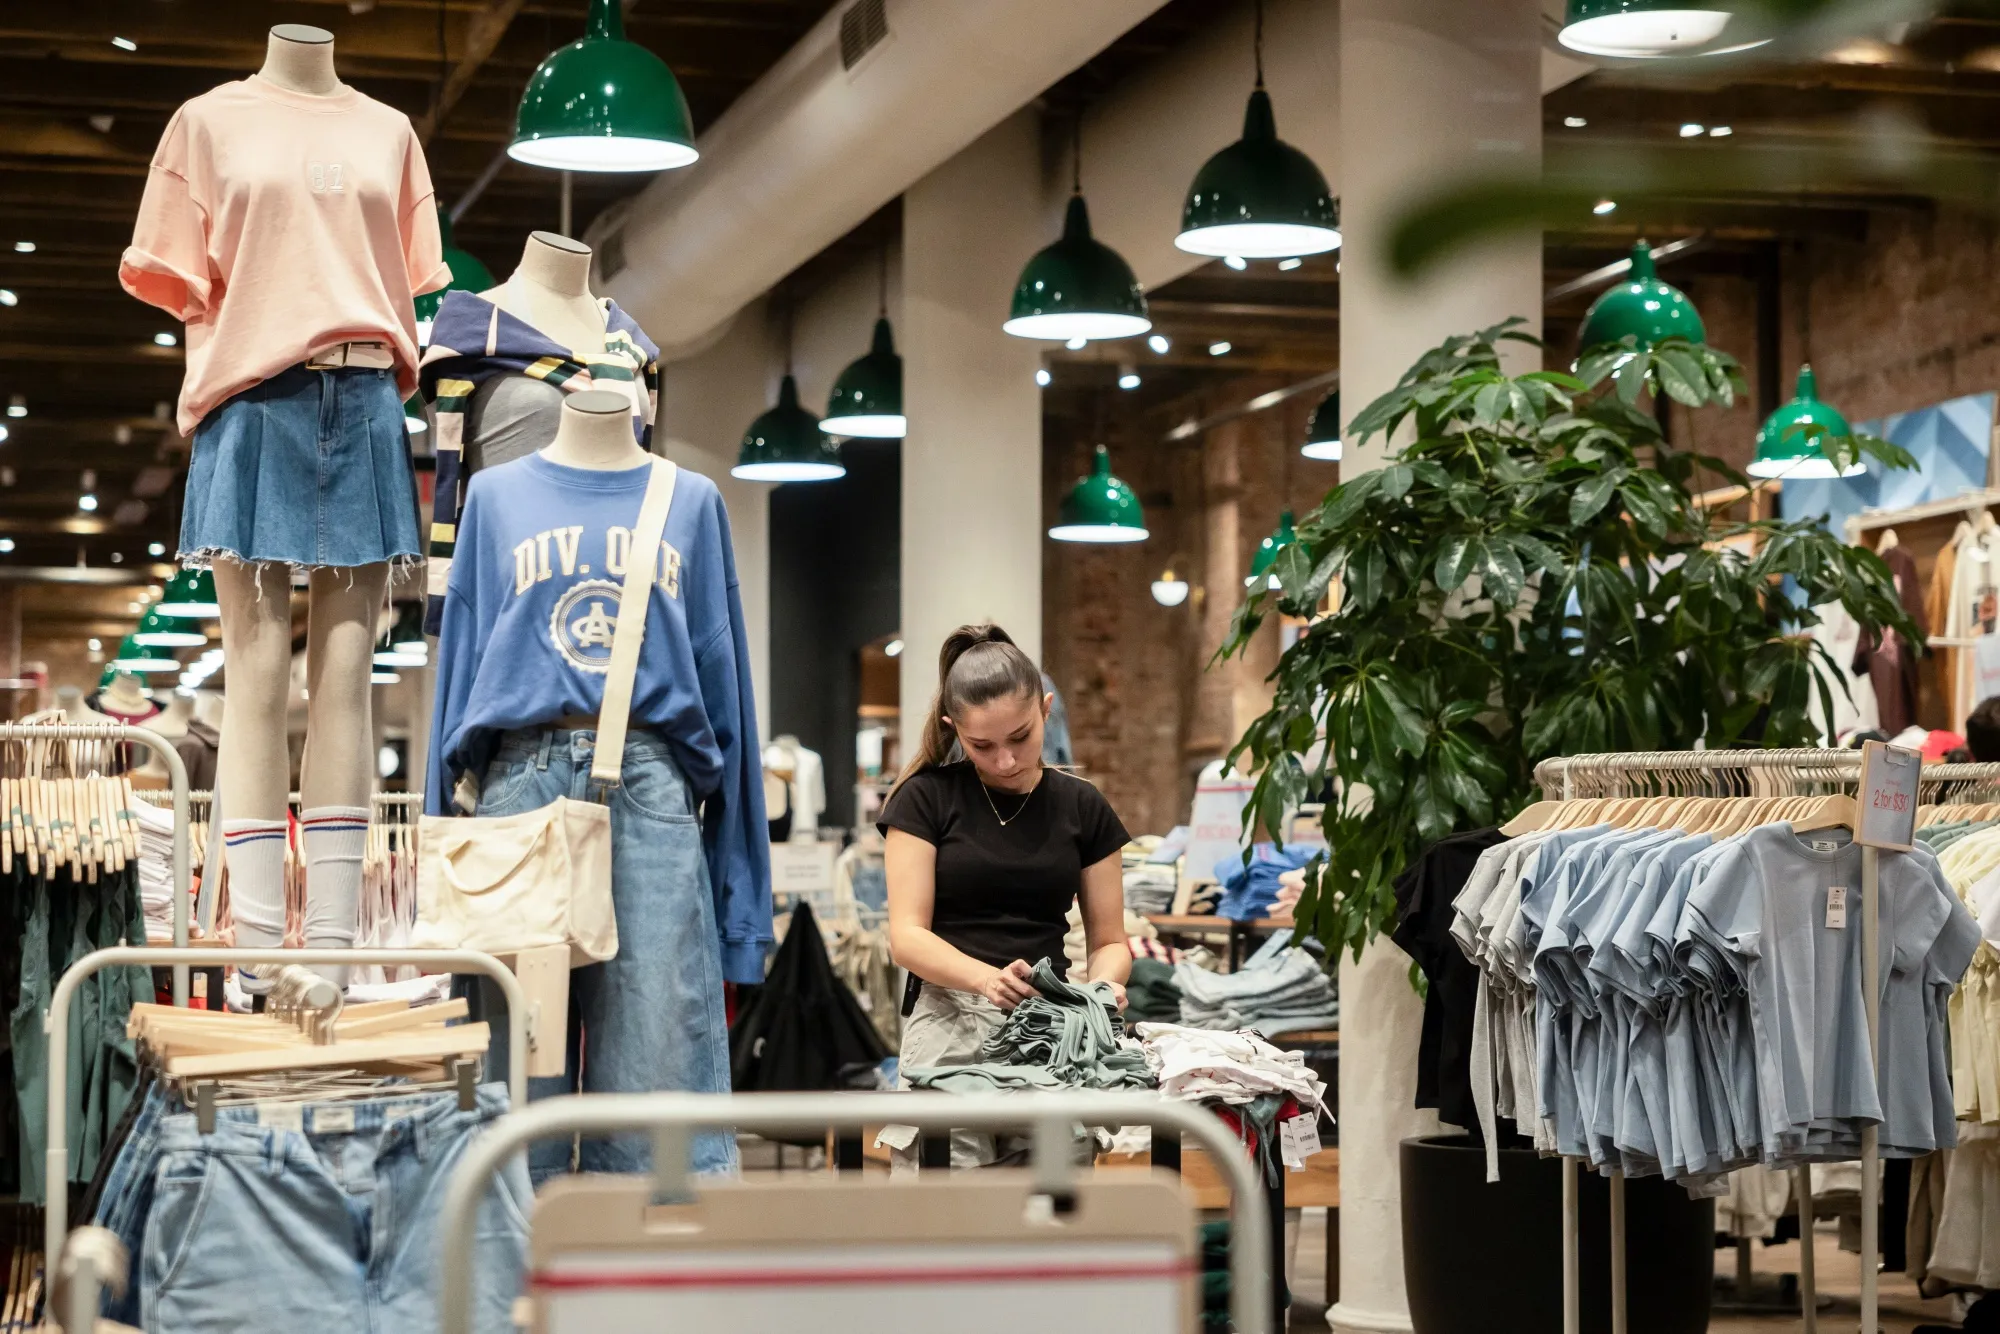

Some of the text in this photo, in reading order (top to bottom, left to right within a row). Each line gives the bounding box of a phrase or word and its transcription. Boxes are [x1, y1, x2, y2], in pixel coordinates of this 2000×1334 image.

[513, 525, 681, 600] DIV. OE
[1873, 789, 1910, 812] 2 for $30
